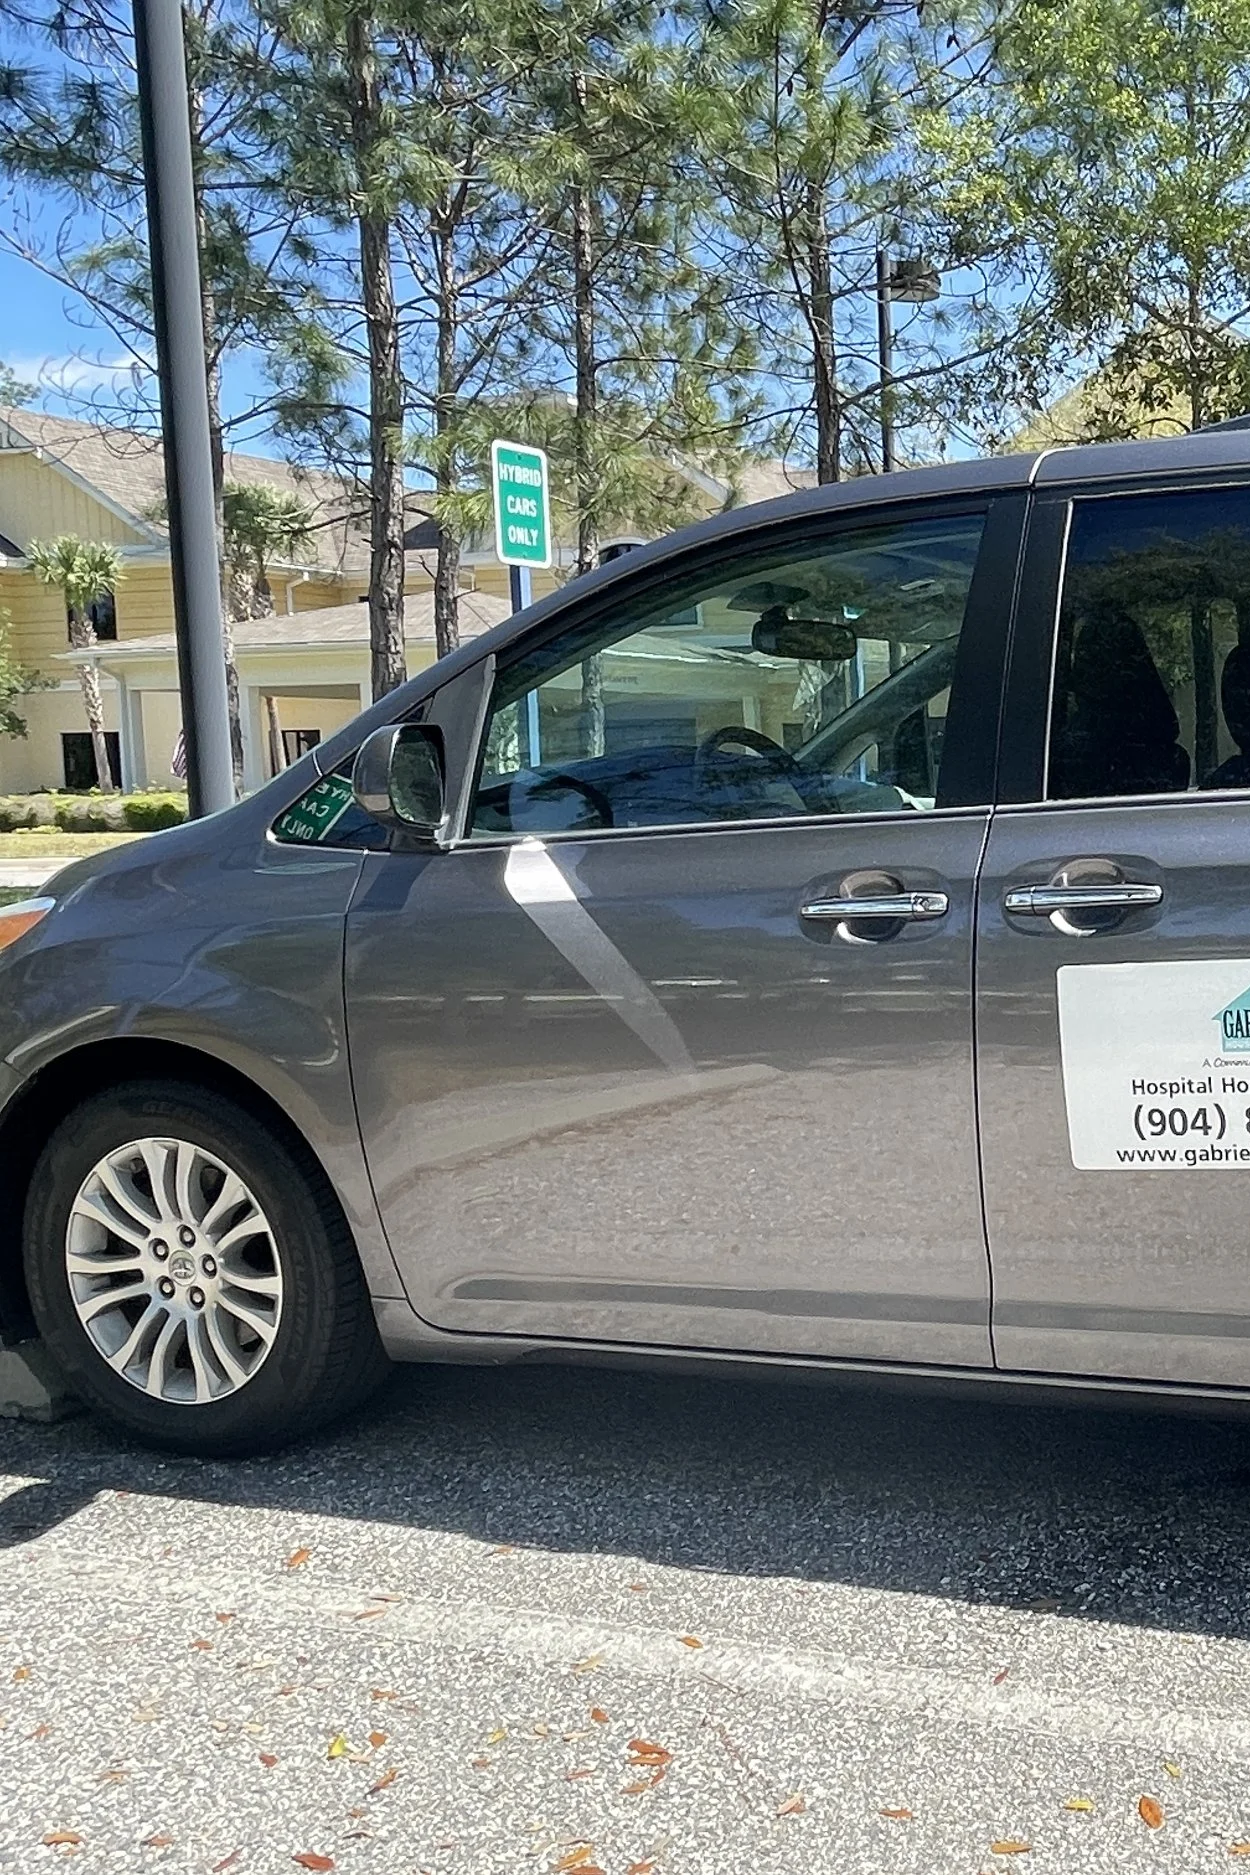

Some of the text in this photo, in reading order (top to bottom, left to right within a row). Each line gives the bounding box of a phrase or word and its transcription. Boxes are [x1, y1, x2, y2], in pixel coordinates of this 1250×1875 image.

[499, 463, 541, 487] HYBRID
[507, 495, 537, 517] CARS
[508, 525, 539, 546] ONLY
[1202, 1058, 1212, 1068] A
[1132, 1076, 1213, 1099] Hospital
[1133, 1102, 1227, 1140] (904)
